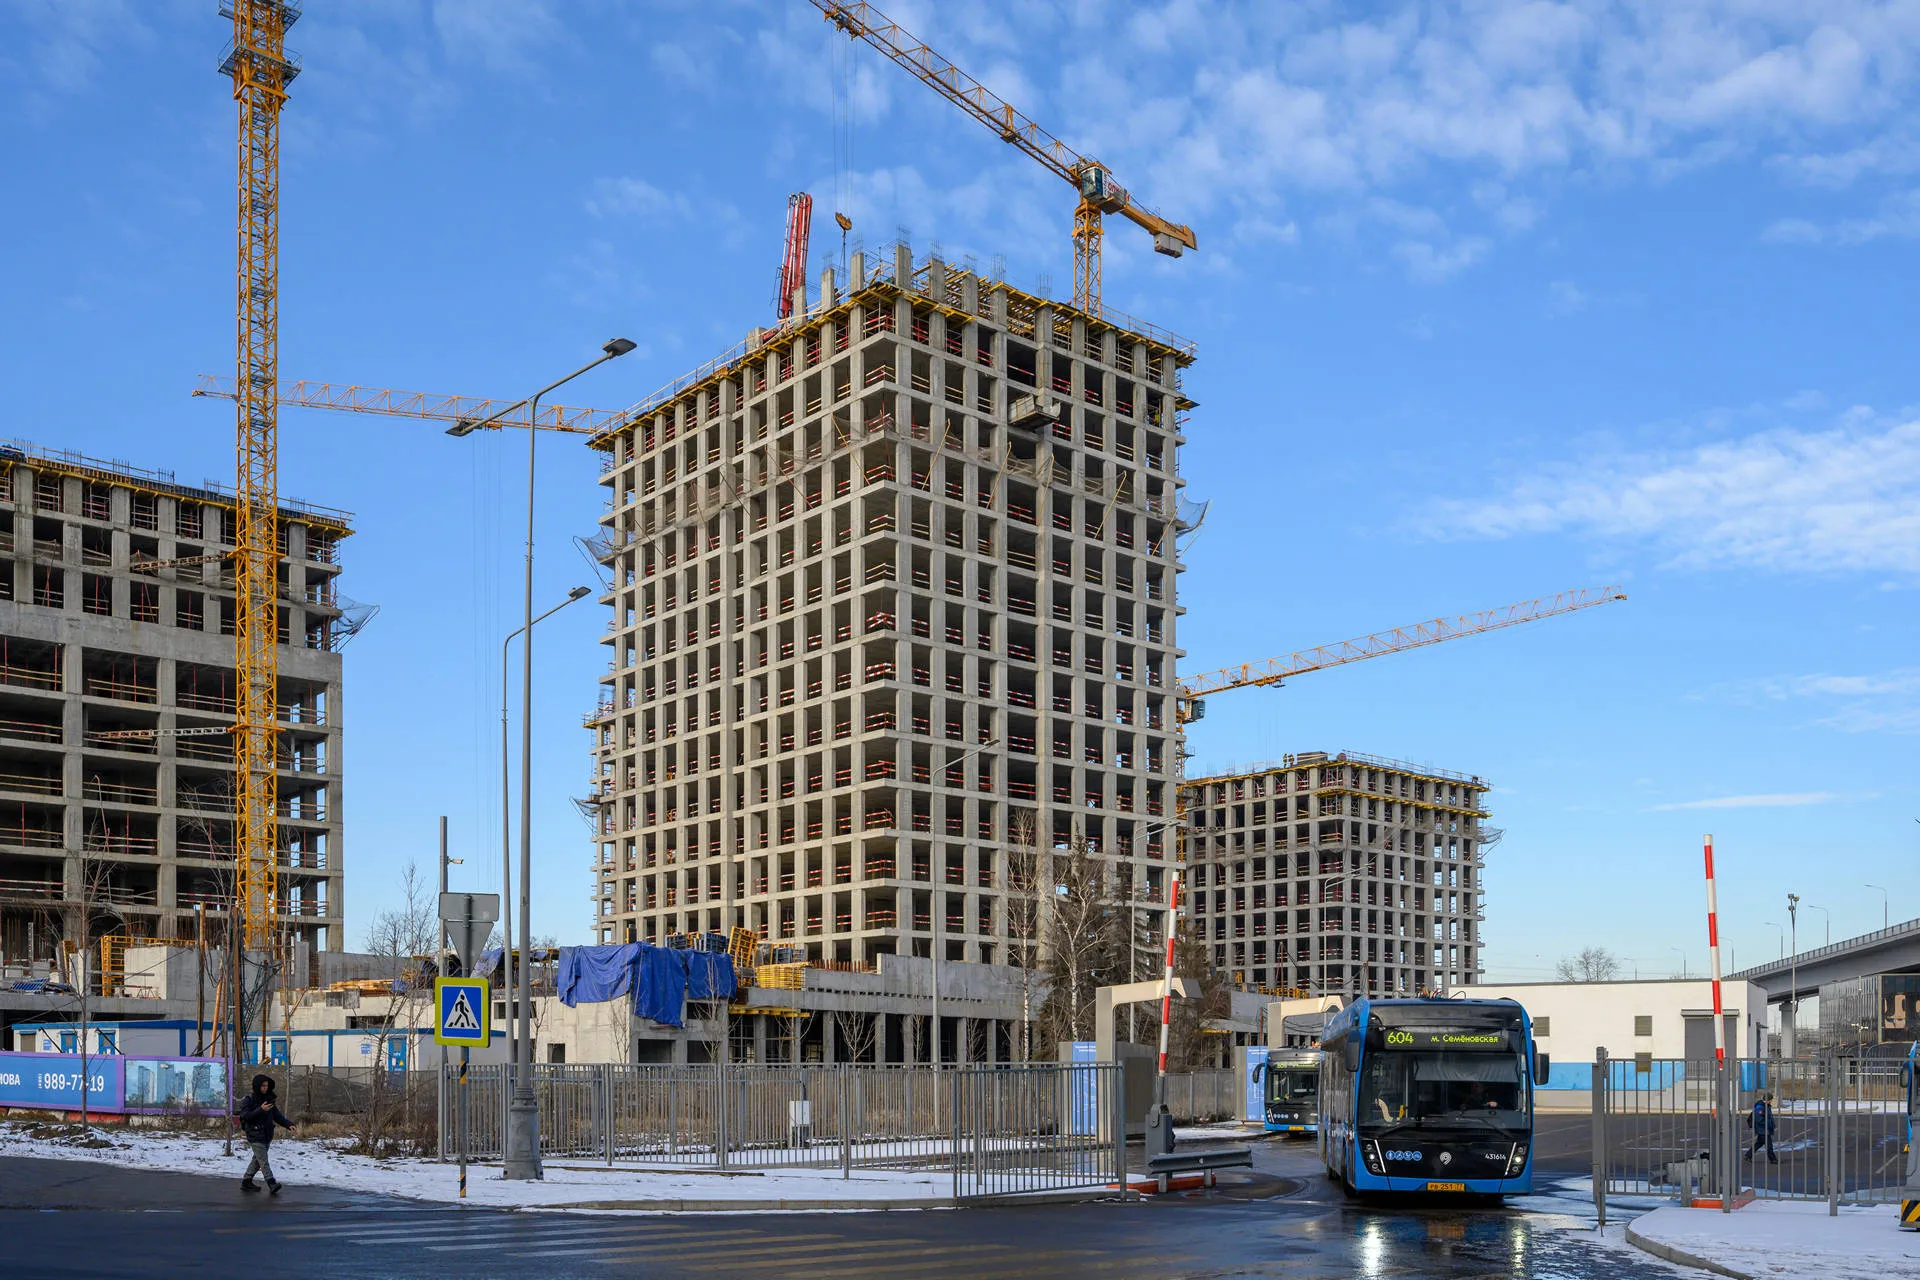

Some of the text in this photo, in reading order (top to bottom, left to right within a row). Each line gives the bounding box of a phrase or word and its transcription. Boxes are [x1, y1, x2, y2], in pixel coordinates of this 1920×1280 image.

[1387, 1031, 1414, 1044] 604
[1430, 1033, 1499, 1043] м. Семёновская
